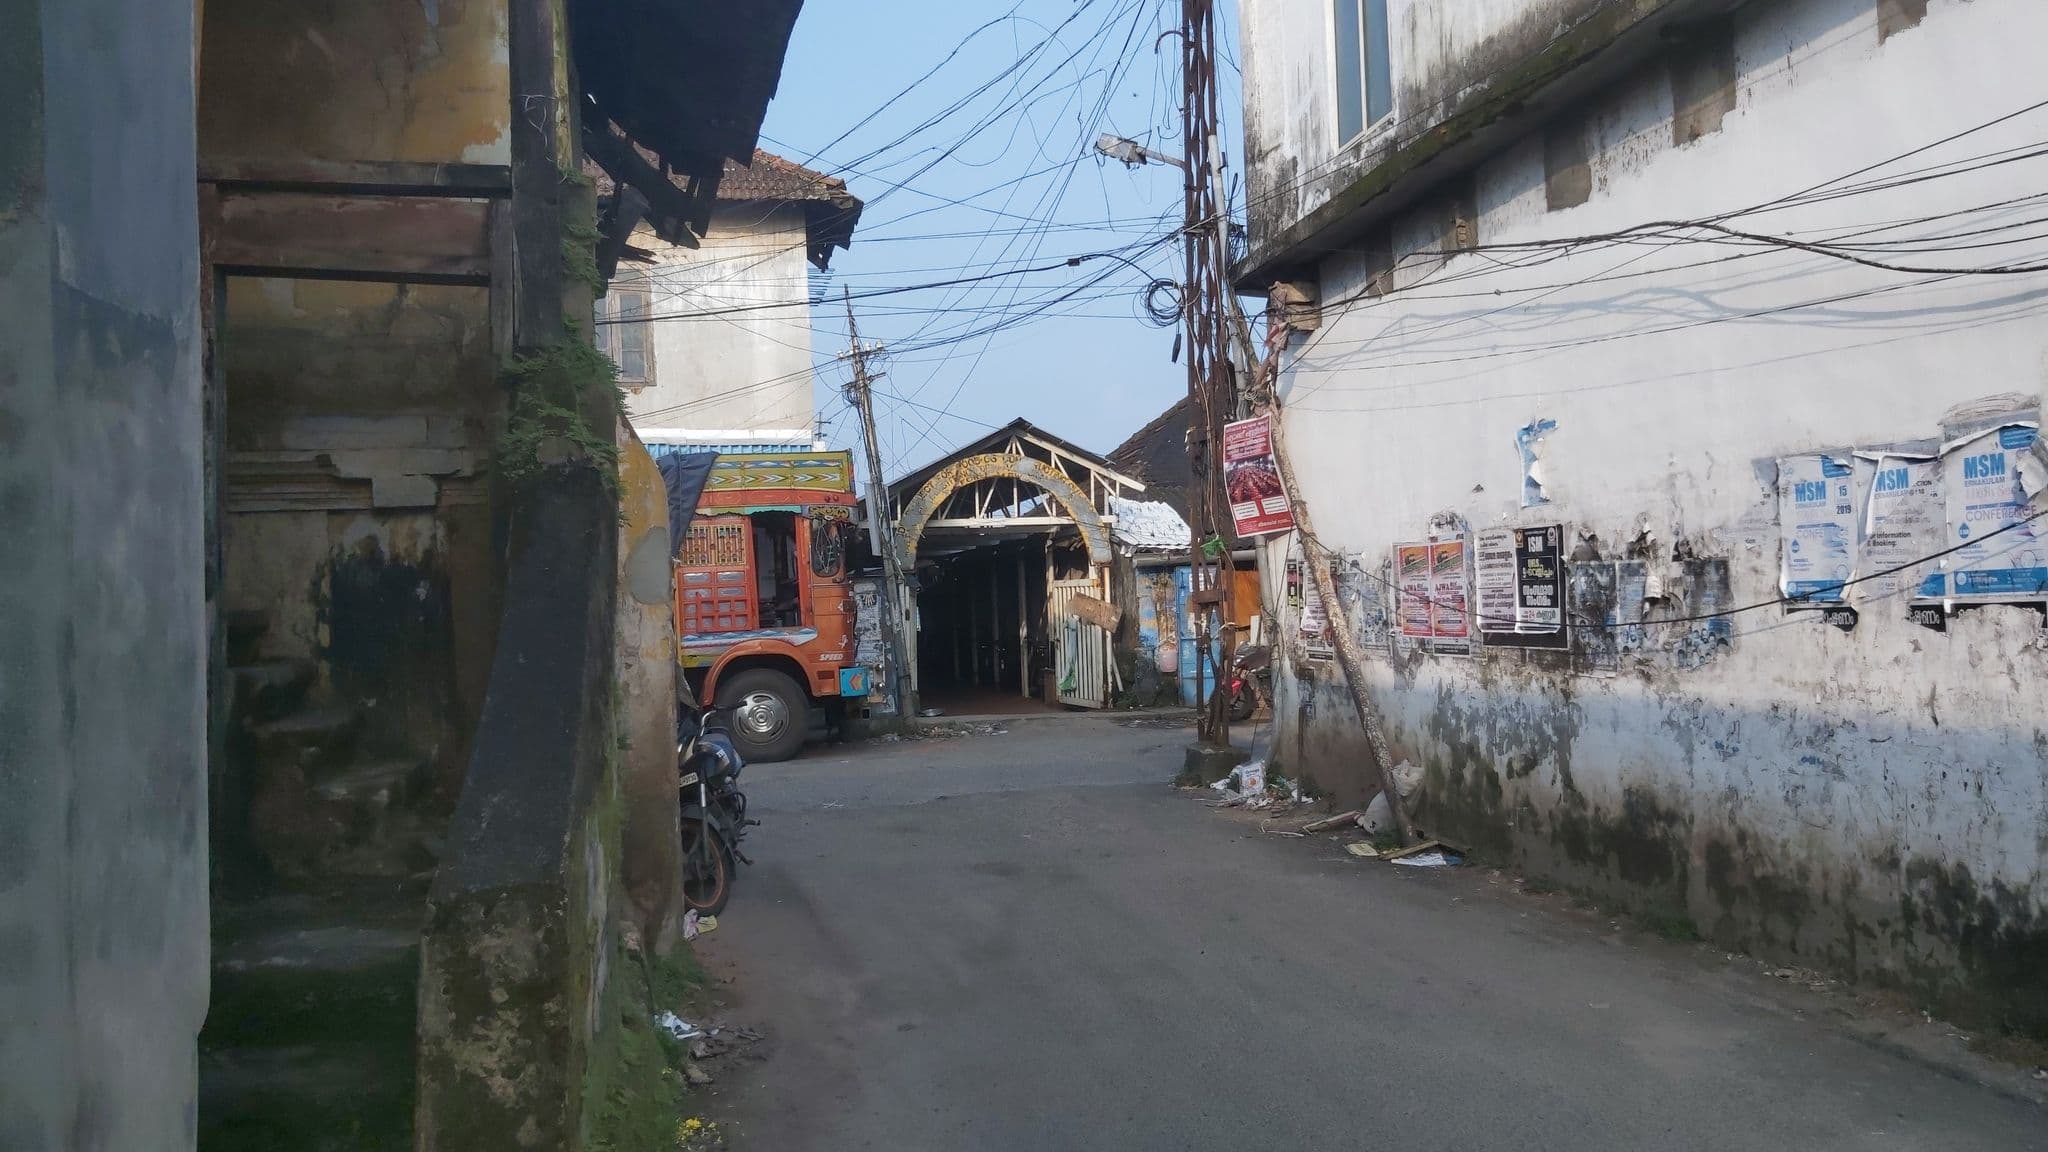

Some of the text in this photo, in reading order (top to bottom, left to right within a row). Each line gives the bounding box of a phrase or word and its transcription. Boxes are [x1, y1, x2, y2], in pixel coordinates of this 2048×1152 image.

[1964, 453, 2005, 479] MSM
[1875, 468, 1909, 492] MSM
[1795, 481, 1826, 502] MSM
[1836, 505, 1853, 515] 2019
[1966, 505, 2037, 522] CONFERENCE
[1527, 536, 1543, 553] ISM
[819, 653, 844, 661] SPEED
